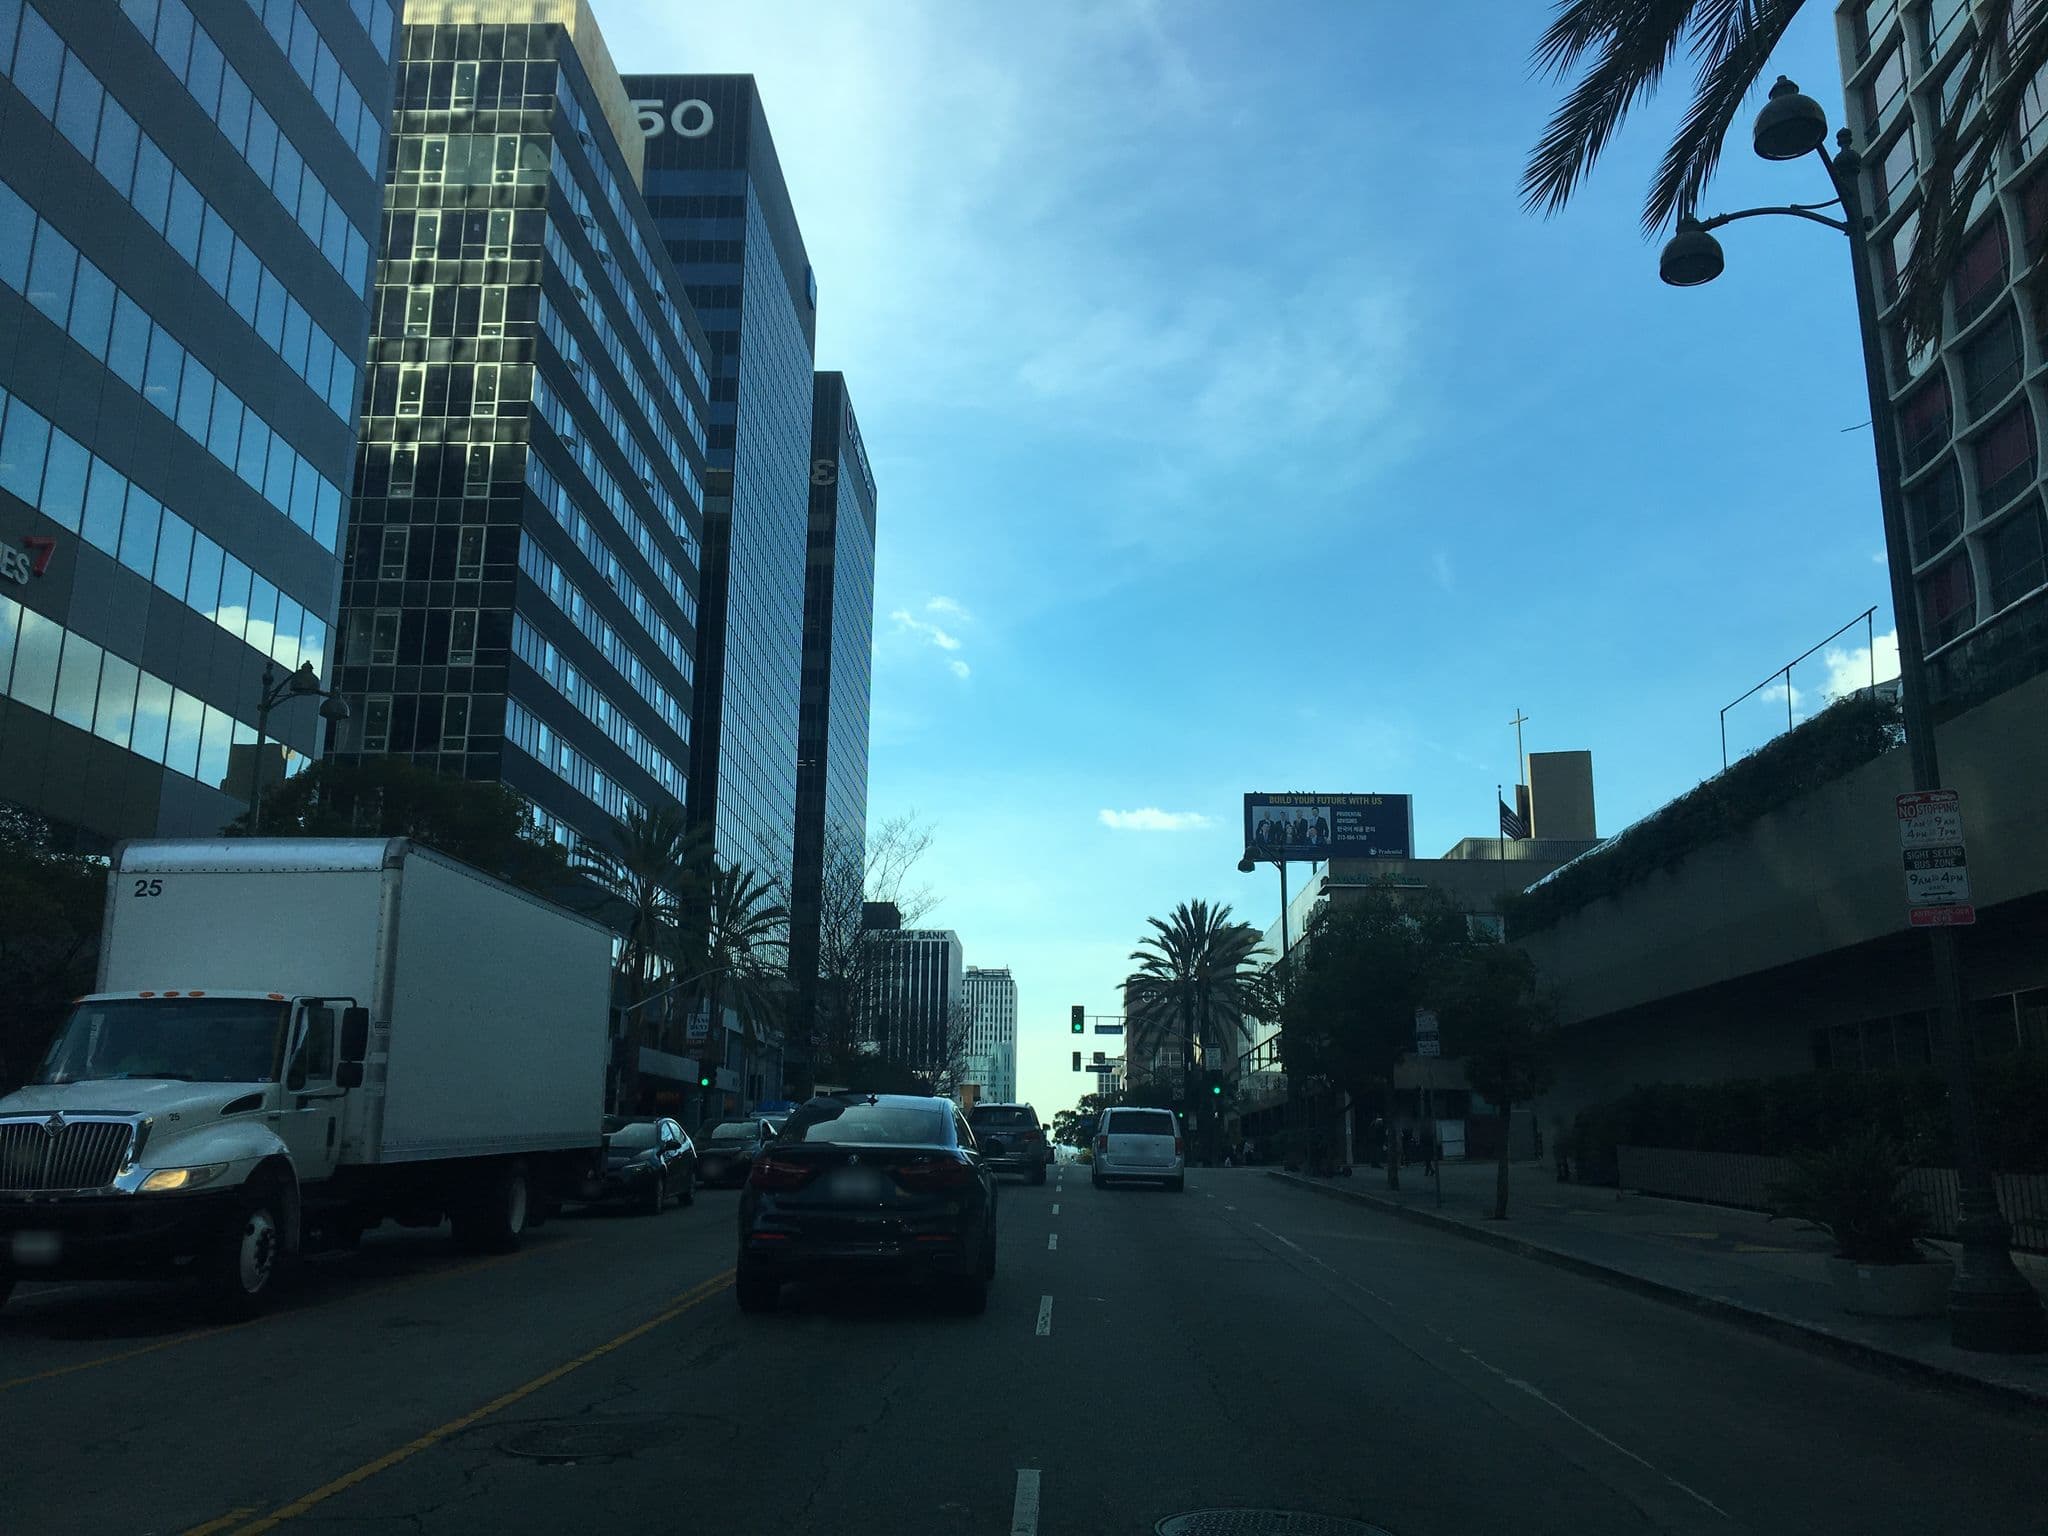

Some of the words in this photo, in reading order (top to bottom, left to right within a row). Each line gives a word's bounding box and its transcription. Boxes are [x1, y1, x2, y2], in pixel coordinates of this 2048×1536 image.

[0, 541, 30, 585] ES
[1268, 795, 1292, 804] BUILD
[1294, 796, 1315, 804] YOUR
[1317, 796, 1346, 804] FUTURE
[1349, 797, 1370, 805] WITH
[1371, 797, 1383, 805] US
[1898, 805, 1916, 819] NO
[1917, 801, 1958, 815] STOPPING
[1906, 850, 1929, 861] SIGHT
[1914, 859, 1931, 869] BUS
[1934, 858, 1957, 868] ZONE
[134, 879, 163, 897] 25
[918, 931, 948, 940] BANK
[168, 1112, 181, 1122] 25
